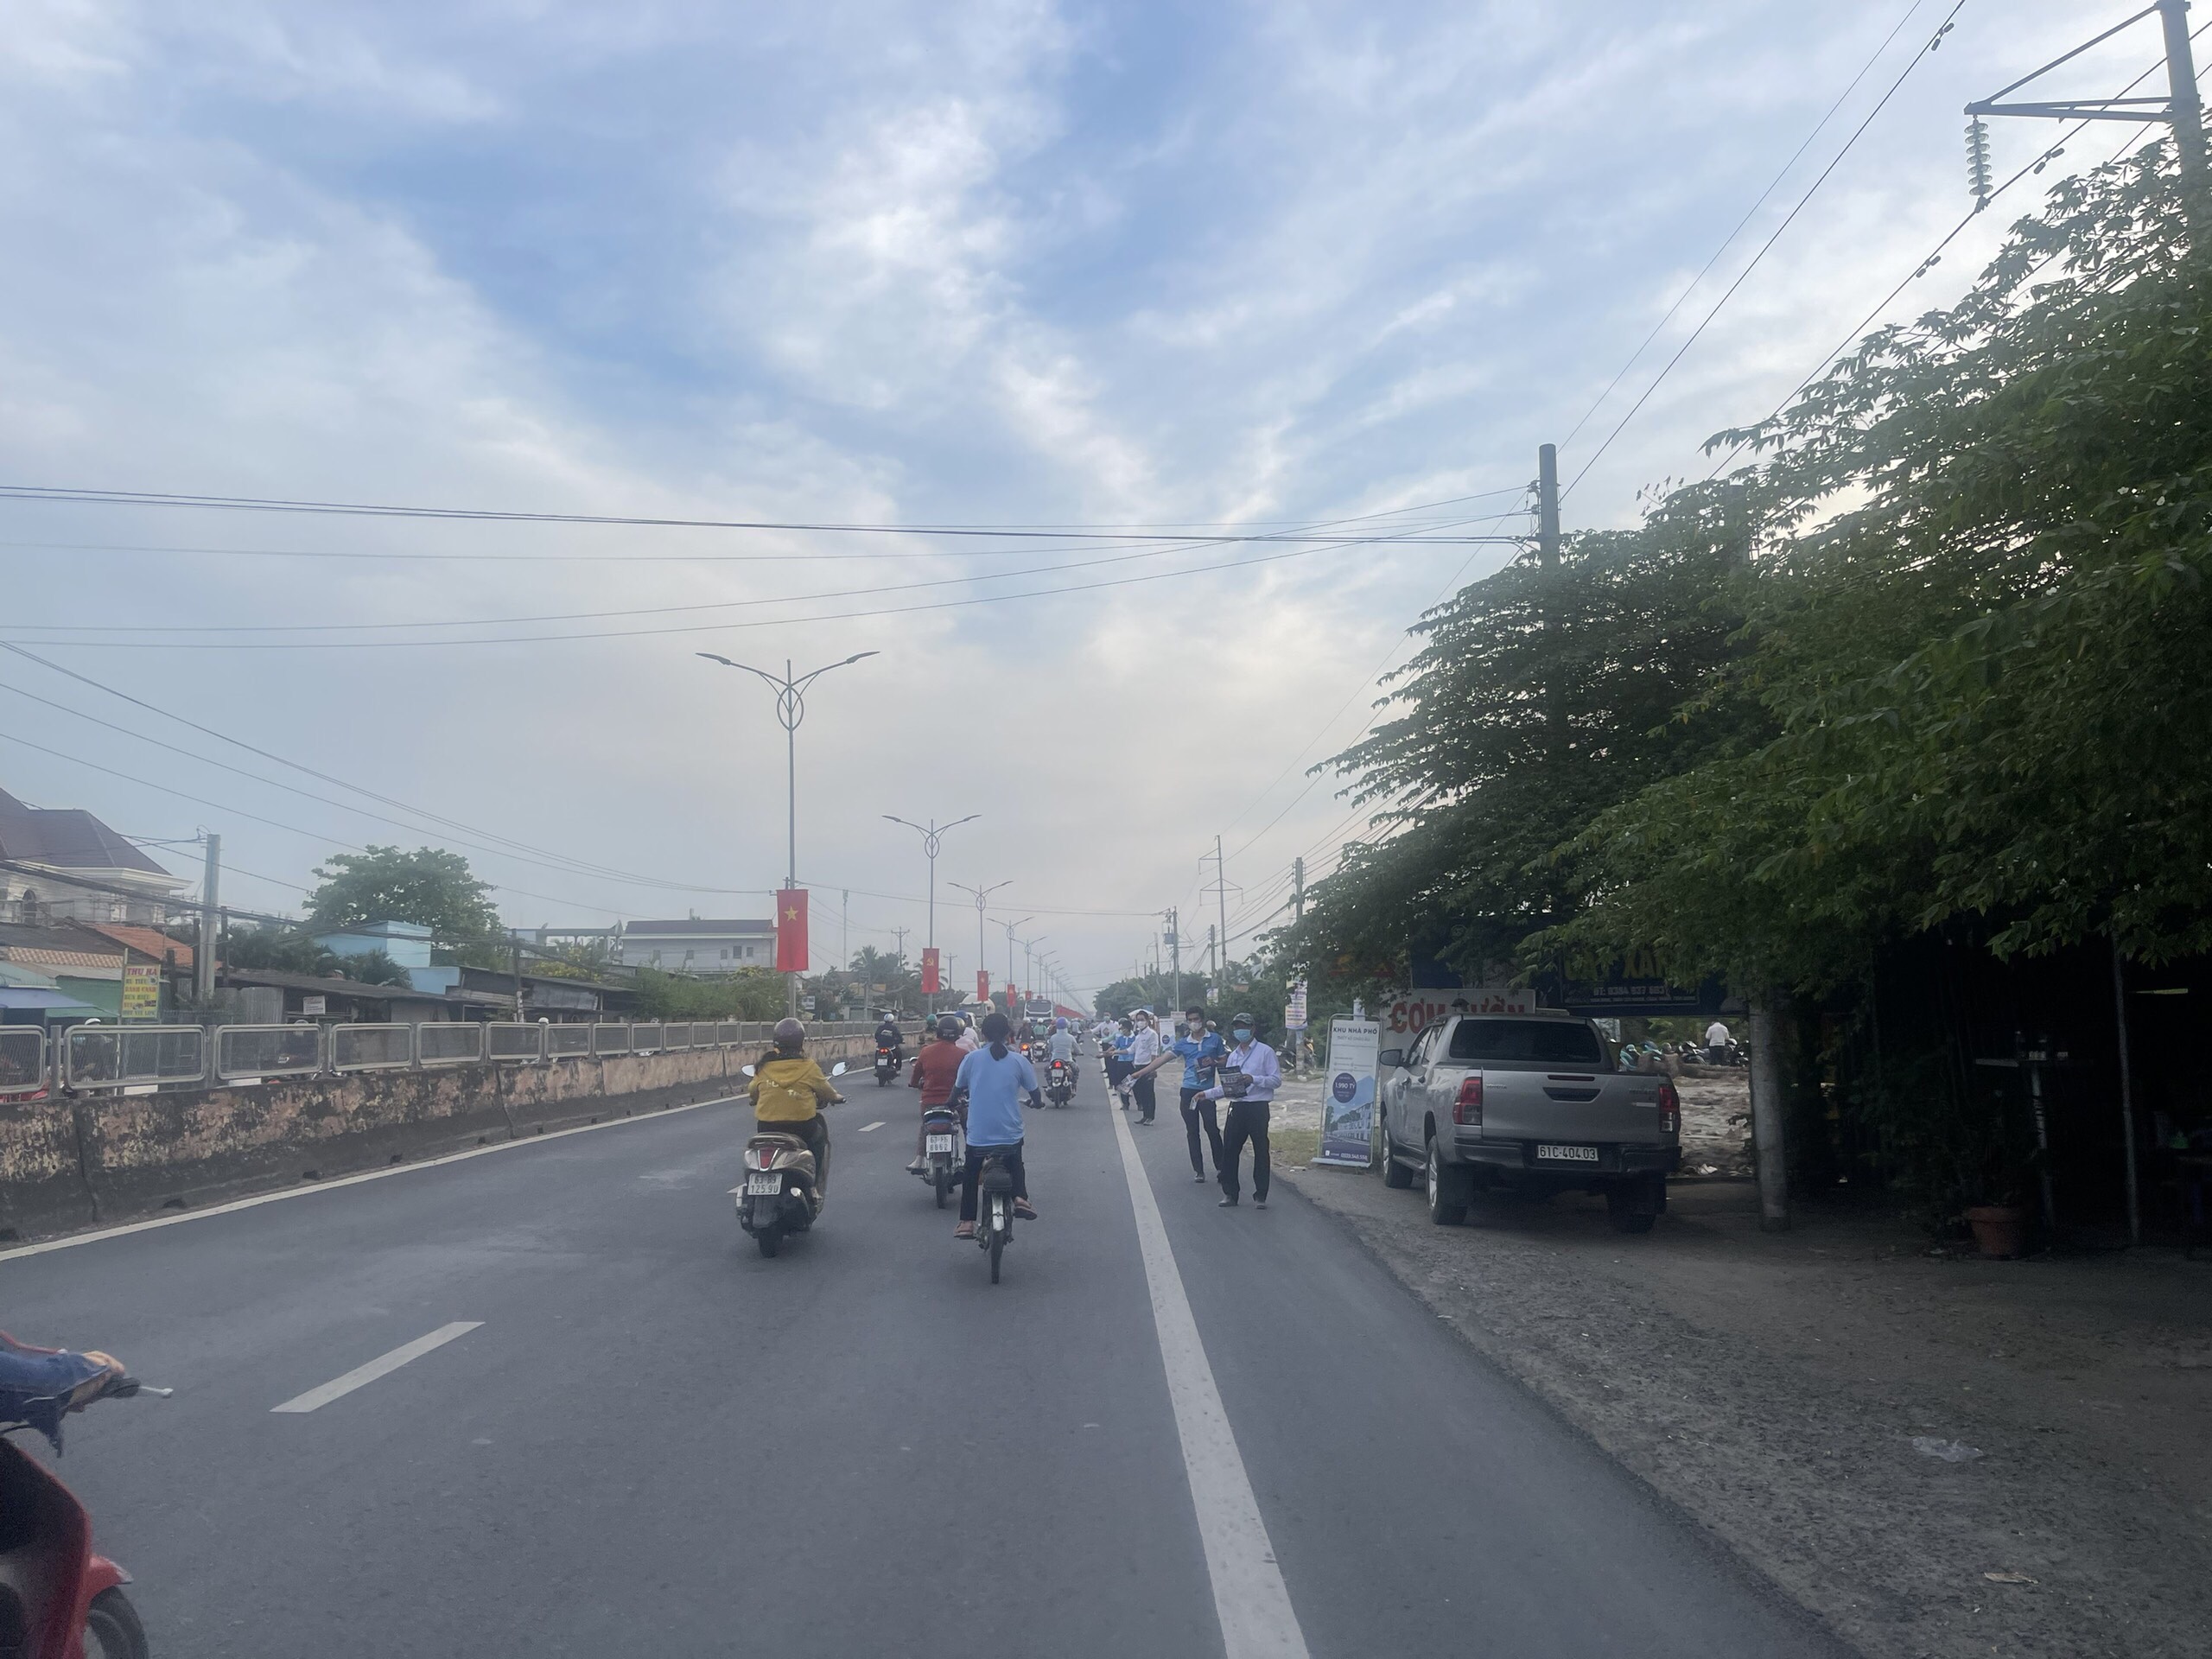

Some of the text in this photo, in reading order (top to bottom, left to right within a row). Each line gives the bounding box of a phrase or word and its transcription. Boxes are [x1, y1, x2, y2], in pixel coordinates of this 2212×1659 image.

[1363, 1027, 1378, 1035] PHỐ
[1540, 1147, 1596, 1160] 61C-404.03
[751, 1185, 779, 1193] 125.90
